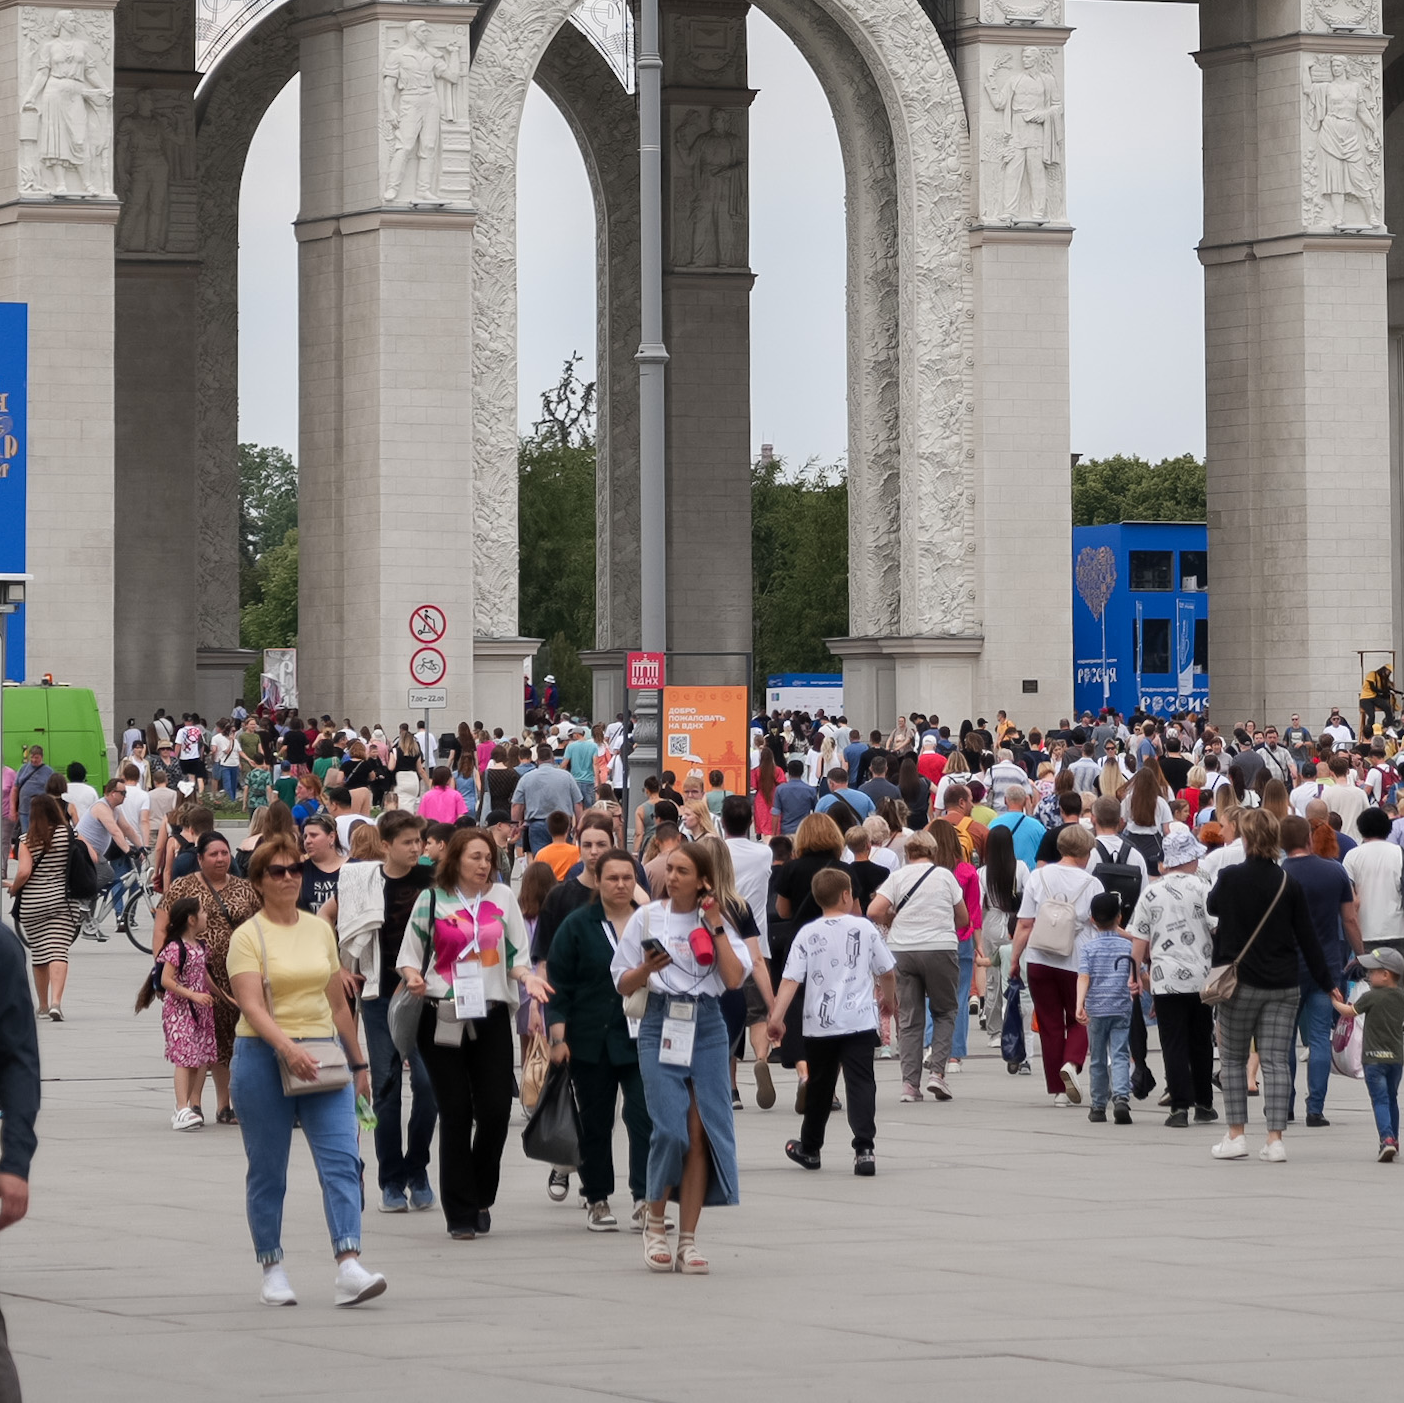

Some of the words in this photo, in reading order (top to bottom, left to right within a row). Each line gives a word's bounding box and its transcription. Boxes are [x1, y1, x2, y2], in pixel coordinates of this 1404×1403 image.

[631, 677, 659, 686] ВДНХ
[668, 707, 697, 716] ДОБРО
[682, 722, 704, 730] ВДНХ
